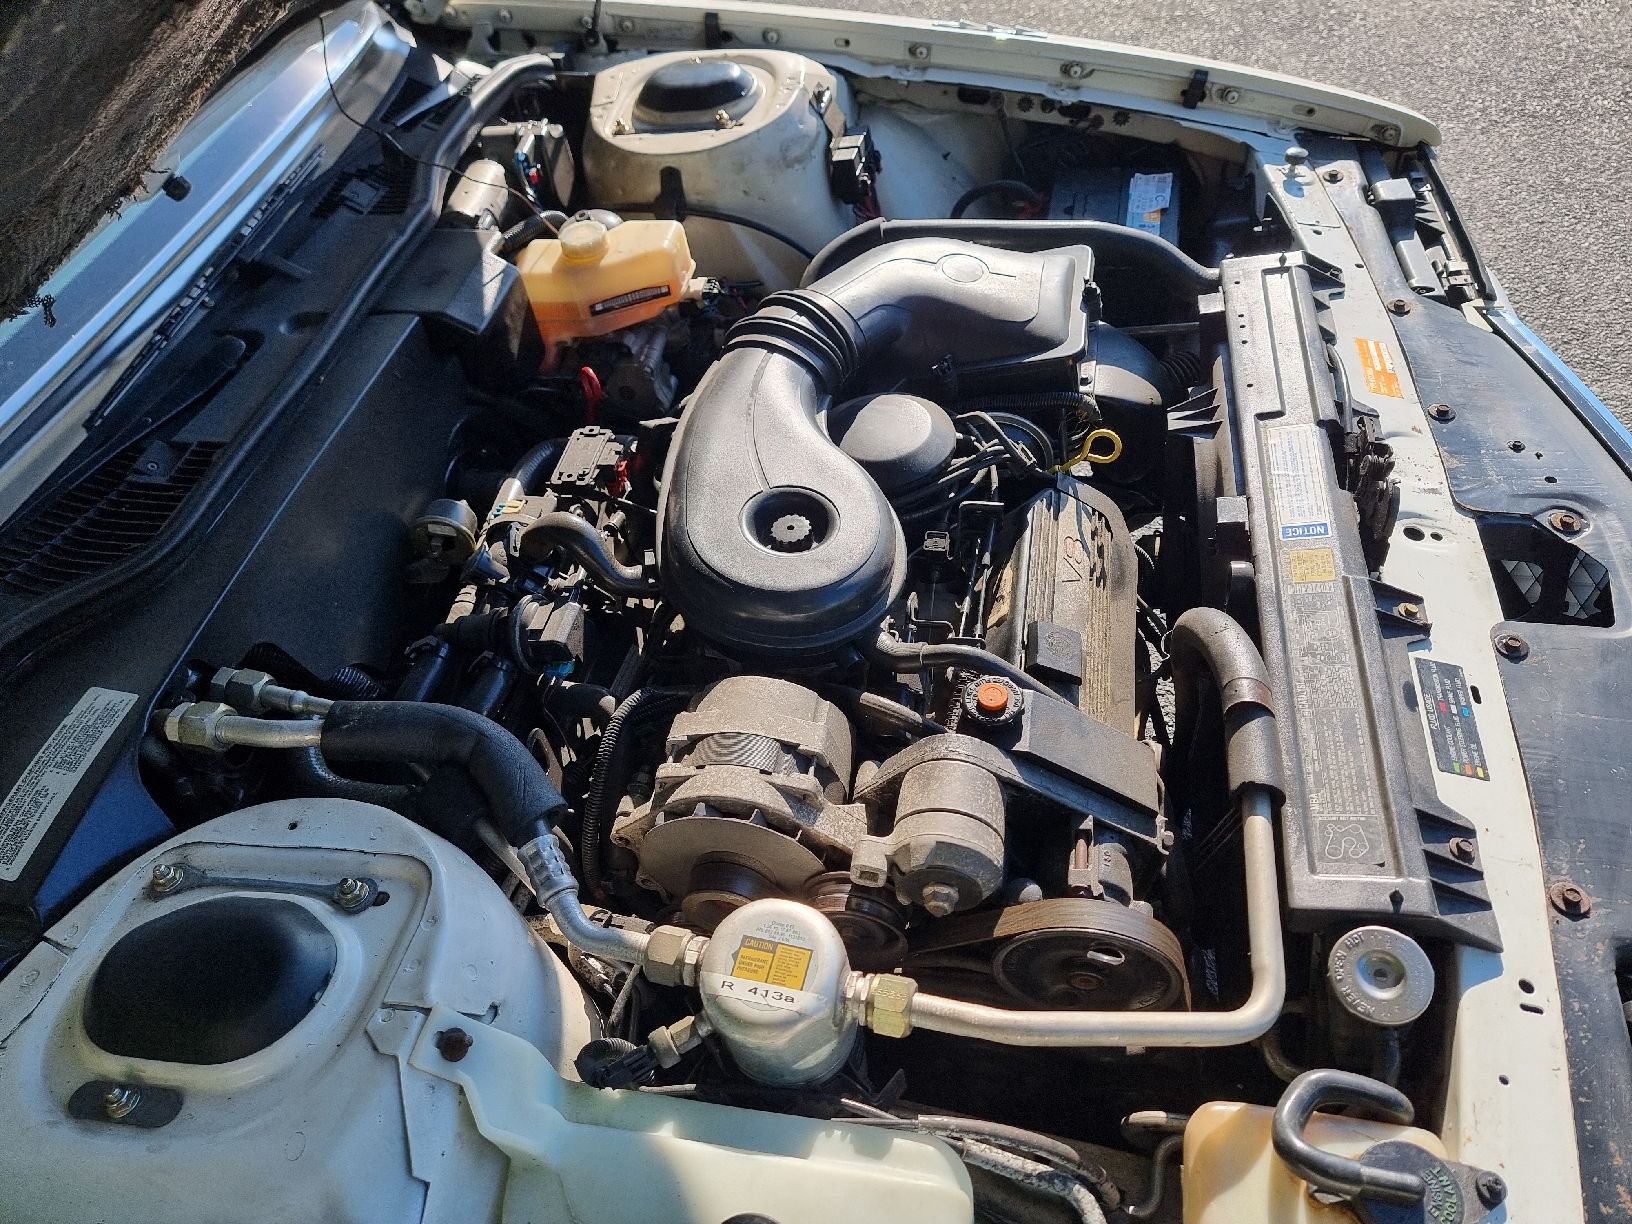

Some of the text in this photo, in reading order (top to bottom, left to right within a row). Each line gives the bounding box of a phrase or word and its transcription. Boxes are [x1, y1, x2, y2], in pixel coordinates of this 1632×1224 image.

[1285, 525, 1325, 537] NOTICE
[745, 938, 774, 950] CAUTION
[1334, 949, 1347, 981] OPEN
[1343, 931, 1364, 948] HOT
[720, 980, 795, 1003] R 413a
[1421, 1169, 1442, 1218] ENGINE
